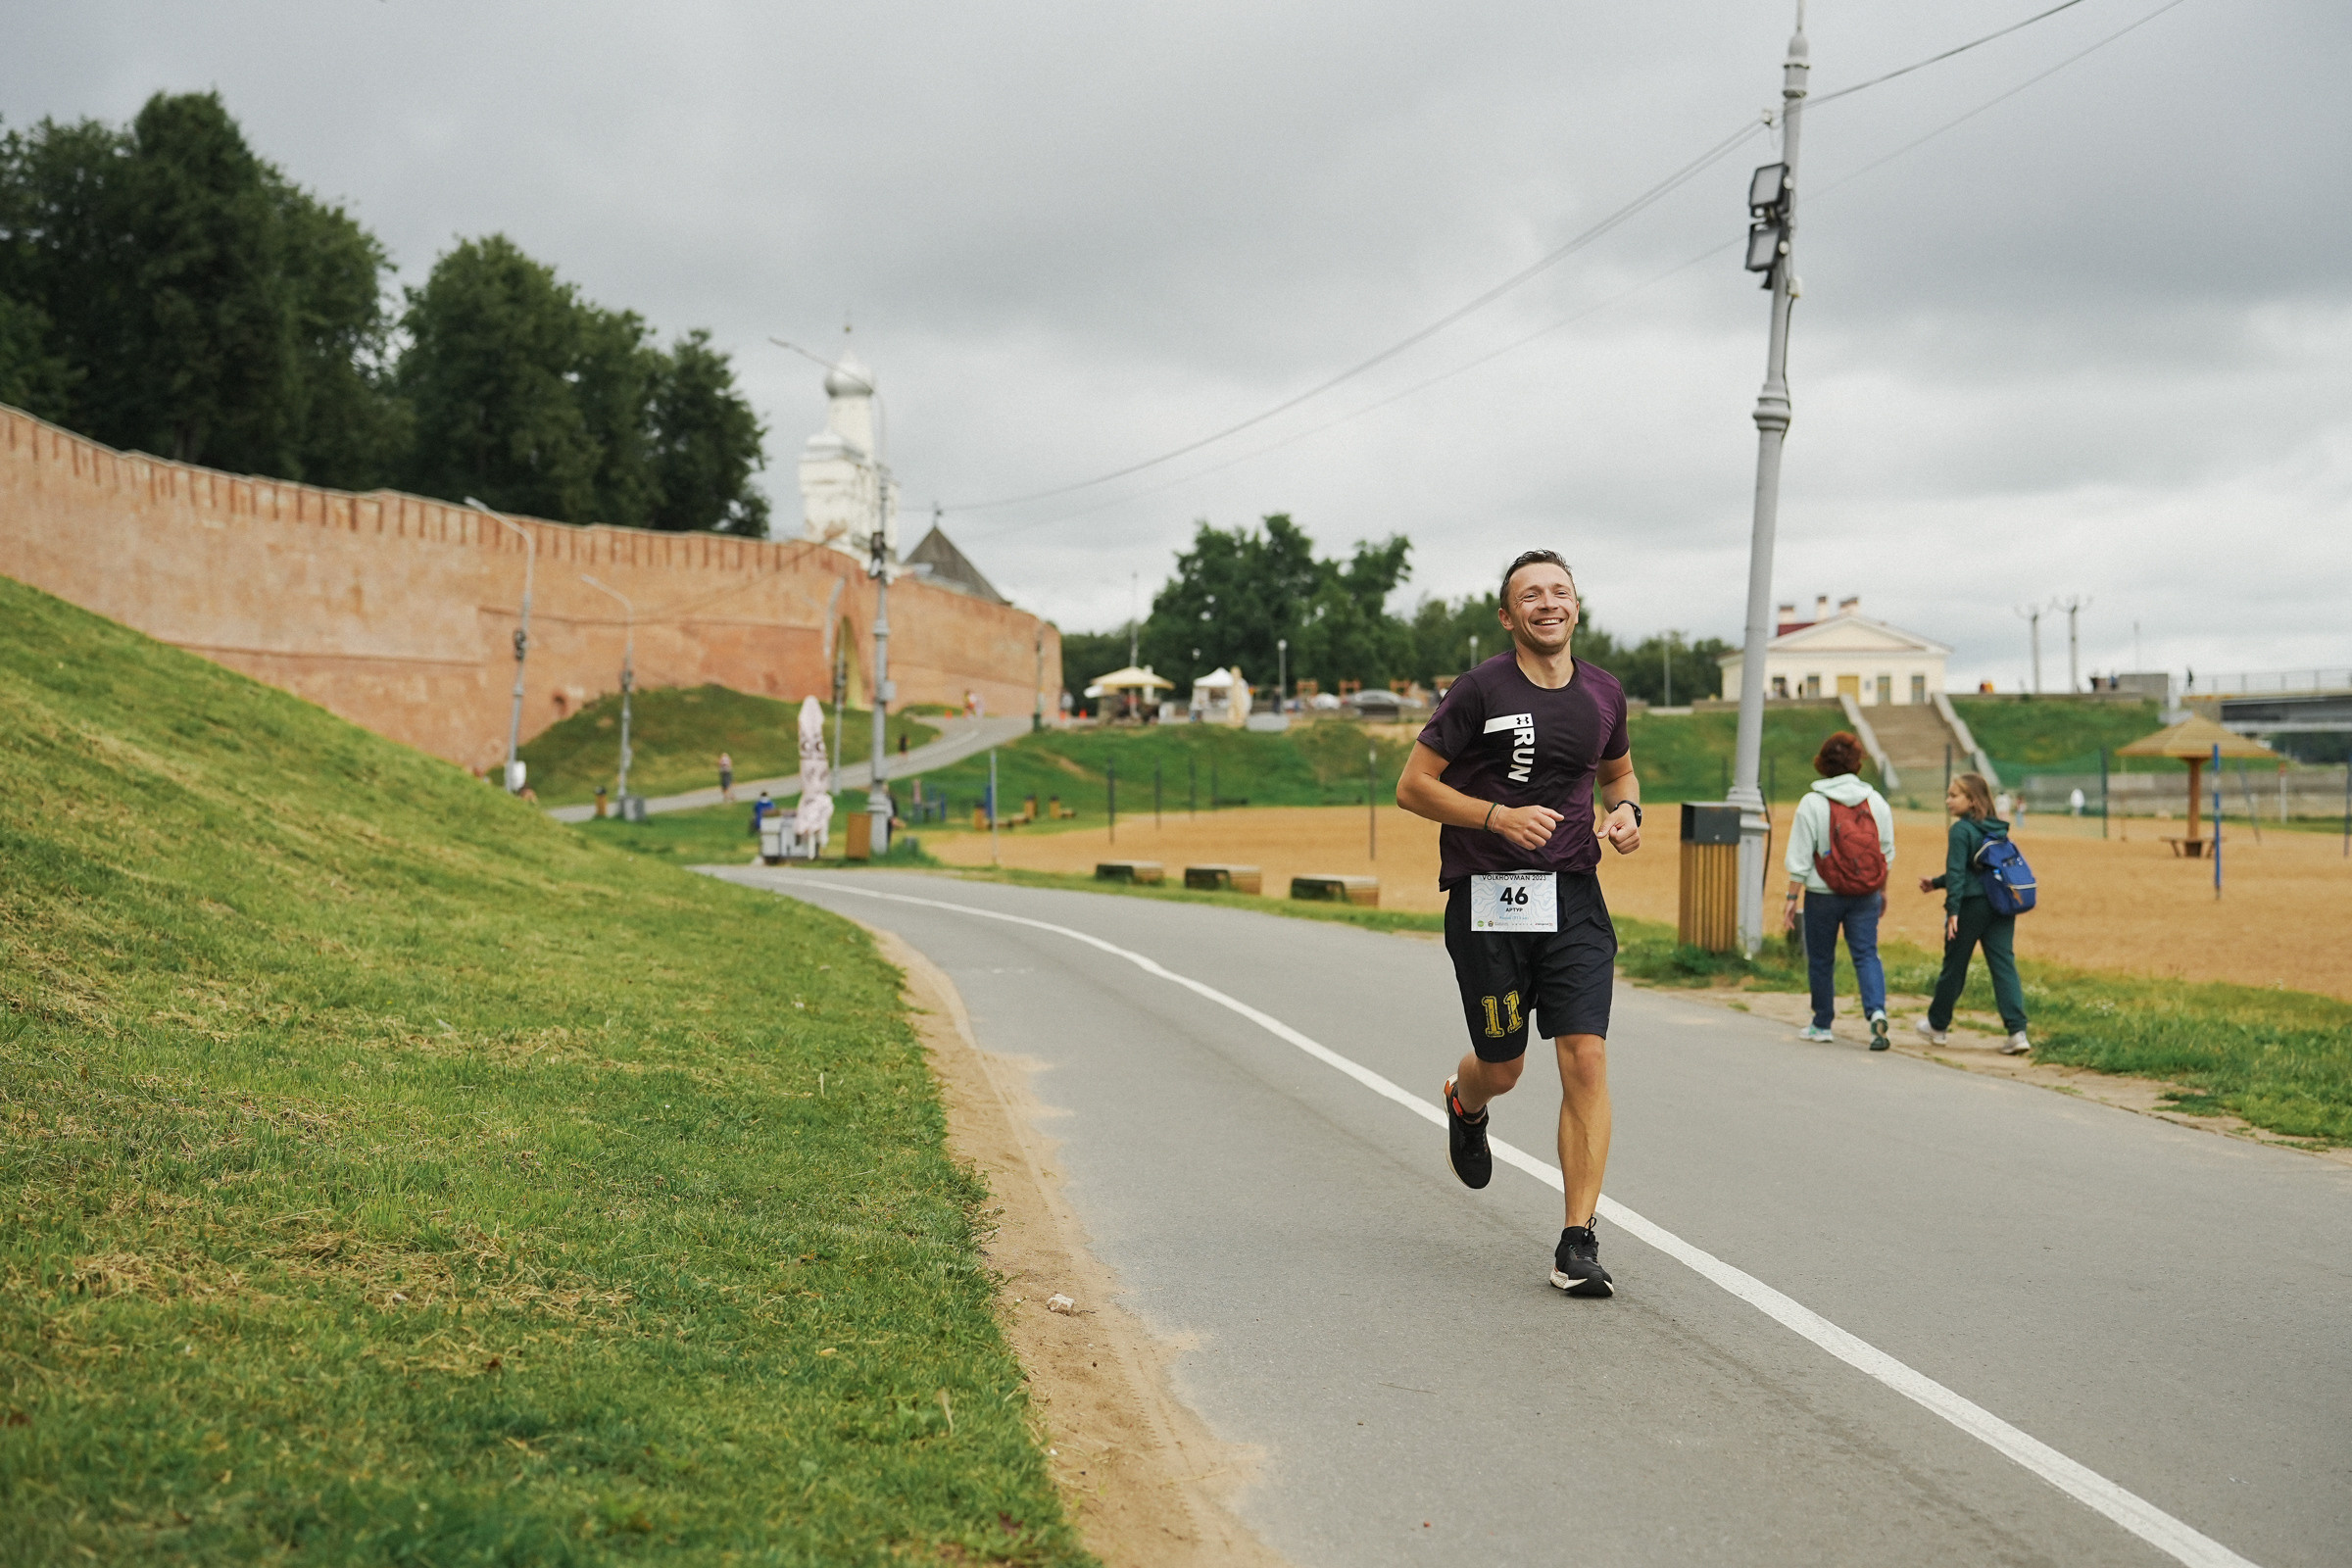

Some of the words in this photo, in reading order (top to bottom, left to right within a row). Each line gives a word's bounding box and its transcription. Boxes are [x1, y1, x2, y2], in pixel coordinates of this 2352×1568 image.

[1507, 727, 1536, 783] RUN
[1499, 886, 1529, 906] 46
[1481, 990, 1524, 1038] 11
